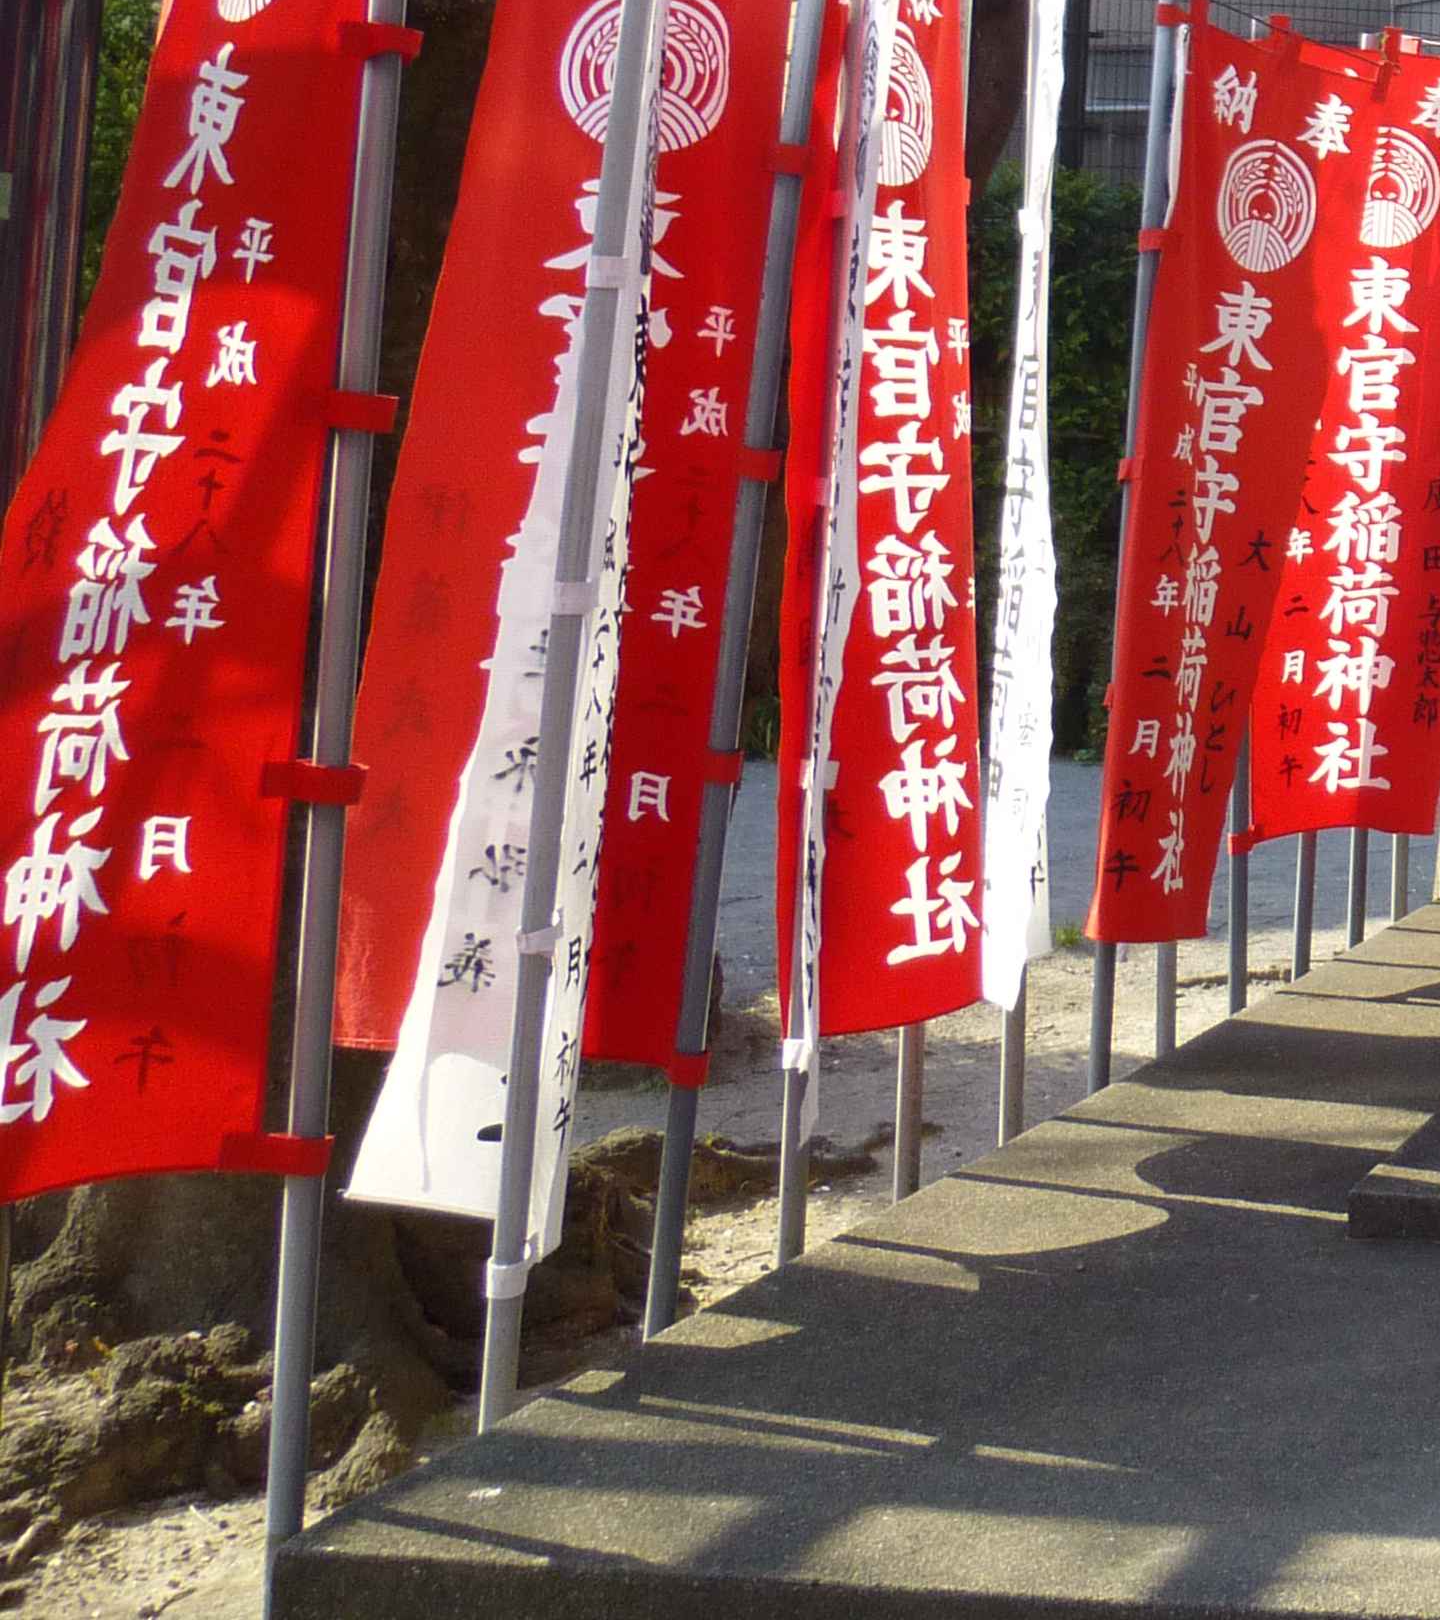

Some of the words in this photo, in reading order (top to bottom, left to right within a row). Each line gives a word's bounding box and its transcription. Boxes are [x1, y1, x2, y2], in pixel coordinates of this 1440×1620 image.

[1307, 256, 1420, 795] 東官守稲荷神社
